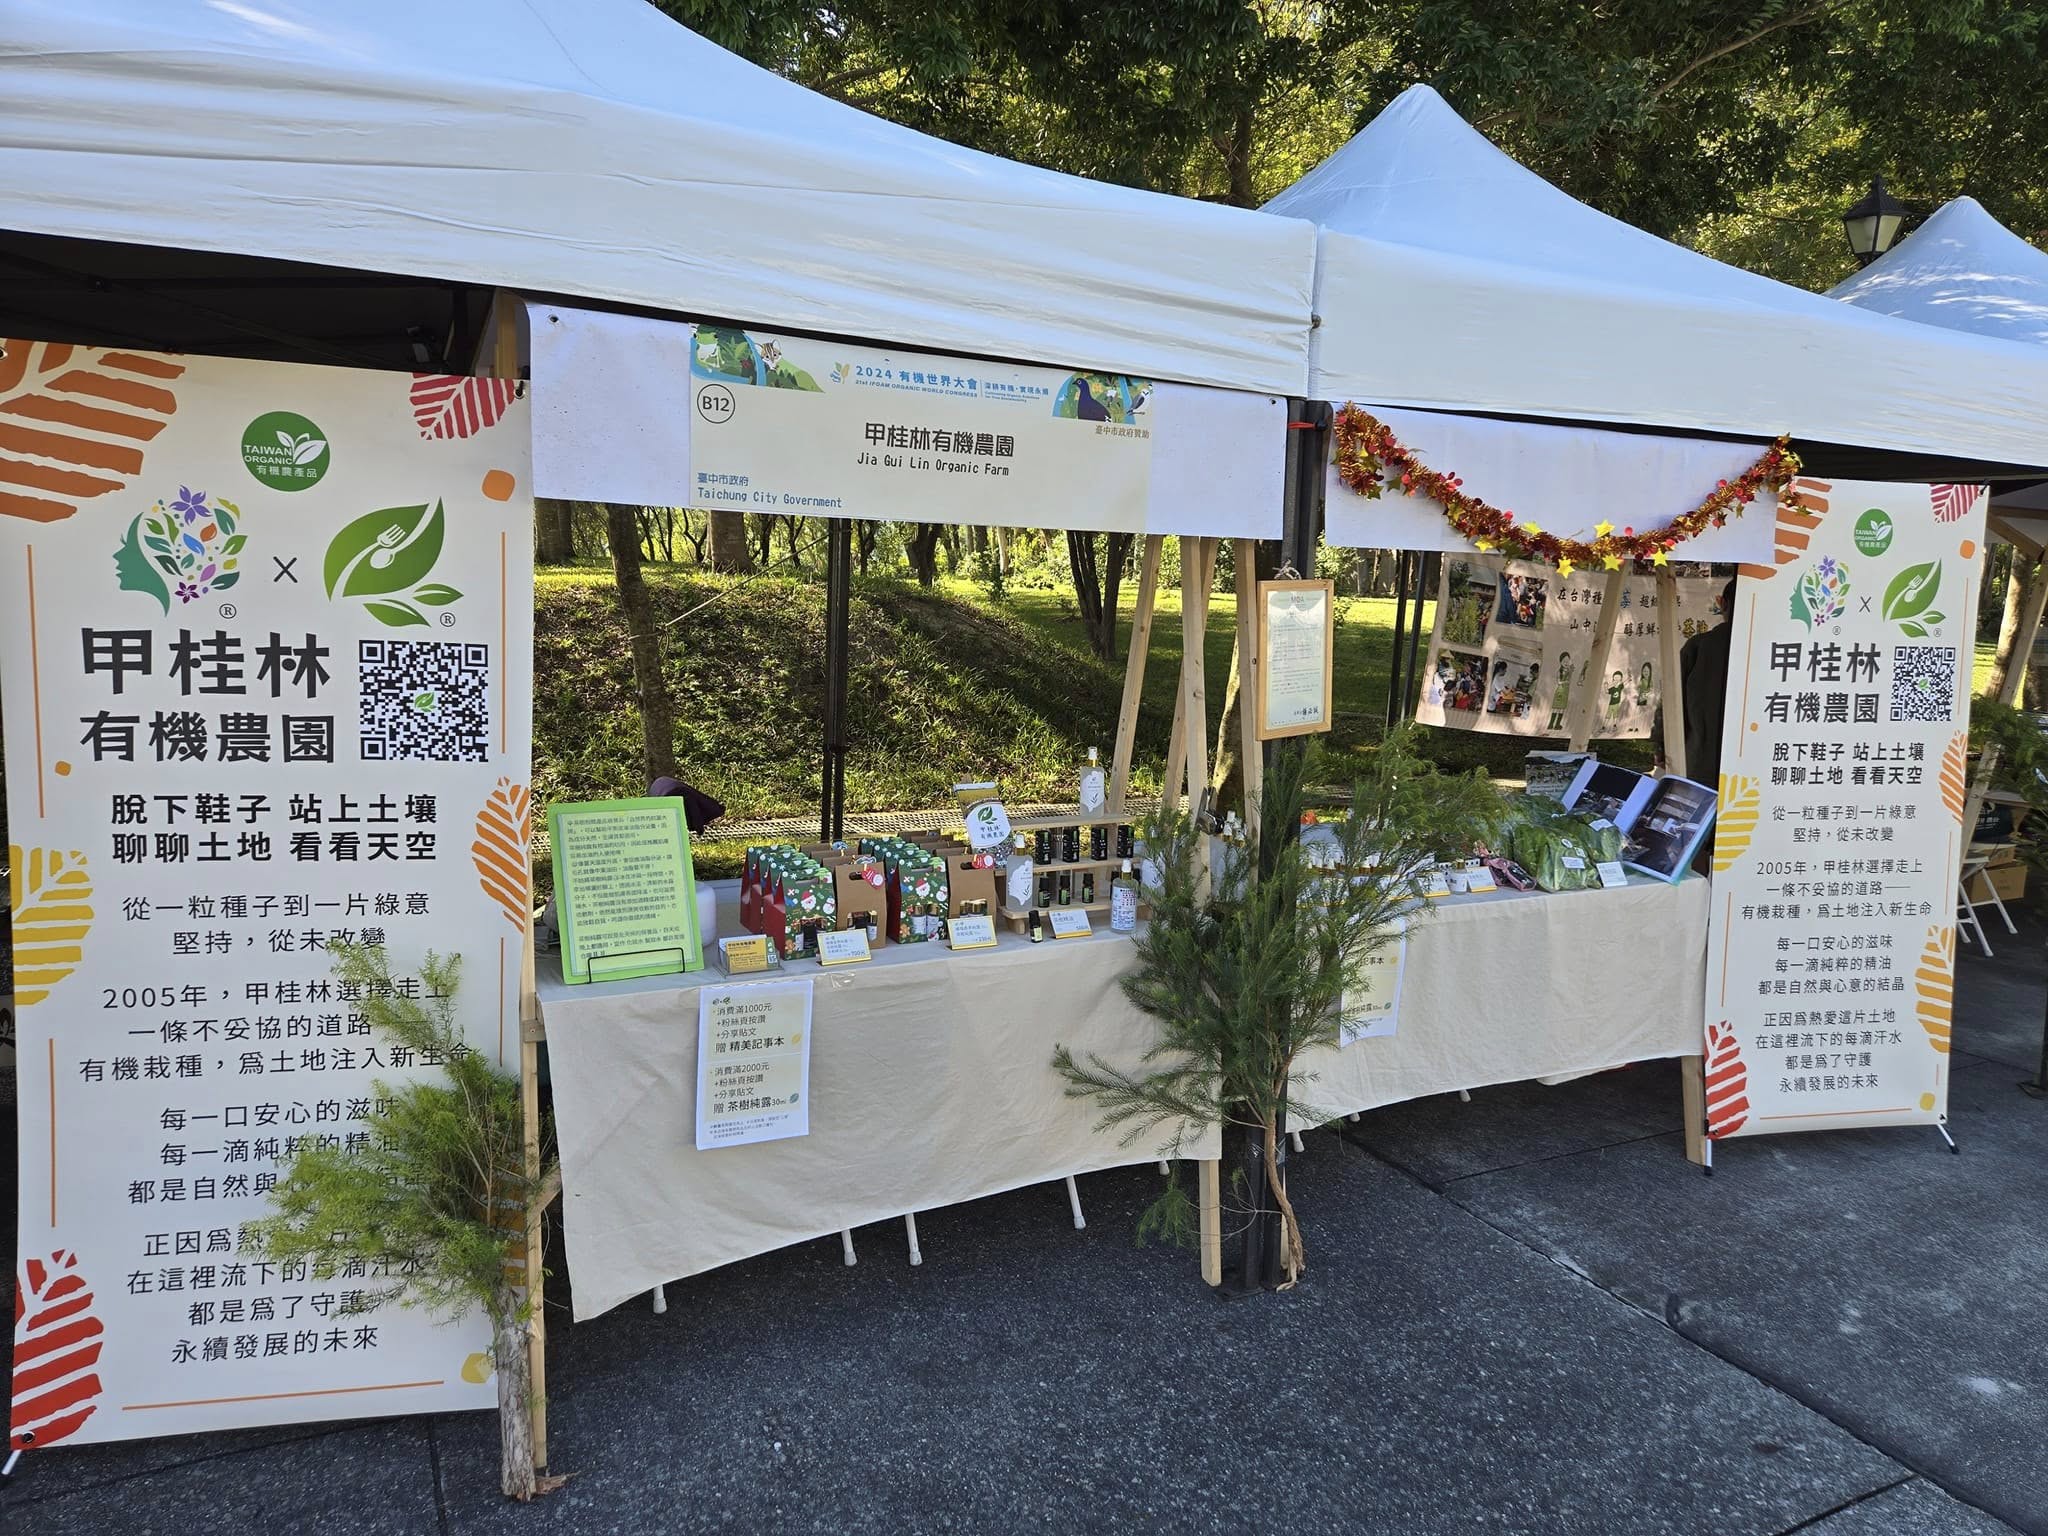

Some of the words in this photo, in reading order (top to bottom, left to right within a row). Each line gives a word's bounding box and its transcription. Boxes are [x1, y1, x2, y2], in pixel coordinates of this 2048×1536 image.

[856, 366, 892, 380] 2024
[899, 370, 978, 390] 有機世界大會
[891, 383, 920, 391] ORGANIC
[922, 386, 943, 394] WORLD
[945, 389, 978, 398] CONGRESS
[702, 396, 730, 412] B12
[865, 422, 1015, 458] 甲桂林有機農園
[243, 444, 293, 457] TAIWAN
[243, 456, 293, 465] ORGANIC
[857, 453, 877, 467] Jia
[884, 456, 902, 468] Gui
[909, 457, 930, 470] Lin
[936, 459, 979, 474] Organic
[985, 463, 1009, 476] Farm
[257, 465, 317, 478] 有機農產品
[697, 472, 749, 487] 臺中市政府
[697, 487, 747, 502] Taichung
[753, 491, 777, 504] City
[783, 494, 842, 508] Government
[81, 627, 330, 699] 甲桂林
[1769, 642, 1881, 683] 甲桂林
[1764, 692, 1880, 723] 有機農園
[80, 711, 335, 763] 有機農園
[1772, 742, 1845, 762] 脫下鞋子
[1852, 742, 1925, 762] 站上土壤
[1771, 767, 1843, 786] 聊聊土地
[1850, 766, 1923, 785] 看看天空
[111, 794, 272, 824] 脫下鞋子
[289, 794, 438, 824] 站上土壤
[1772, 804, 1916, 821] 從一粒種子到一片綠意
[1793, 827, 1894, 843] 堅持，從未改變
[112, 831, 273, 864] 聊聊土地
[290, 831, 437, 862] 看看天空
[1757, 858, 1923, 875] 2005年，甲桂林選擇走上
[122, 892, 430, 922] 從一粒種子到一片綠意
[1776, 934, 1893, 951] 每一口安心的滋味
[1775, 955, 1892, 973] 每一滴純粹的精油
[1758, 976, 1905, 995] 都是自然與心意的結晶
[717, 1002, 772, 1016] 消費滿1000元
[715, 1042, 726, 1053] 贈
[729, 1036, 785, 1052] 精美記事本
[1755, 1029, 1902, 1050] 在這裡流下的每滴汗水
[715, 1062, 770, 1076] 消費滿2000元
[1779, 1073, 1879, 1093] 永續發展的未來
[713, 1102, 725, 1114] 贈
[172, 1325, 379, 1364] 永續發展的未來
